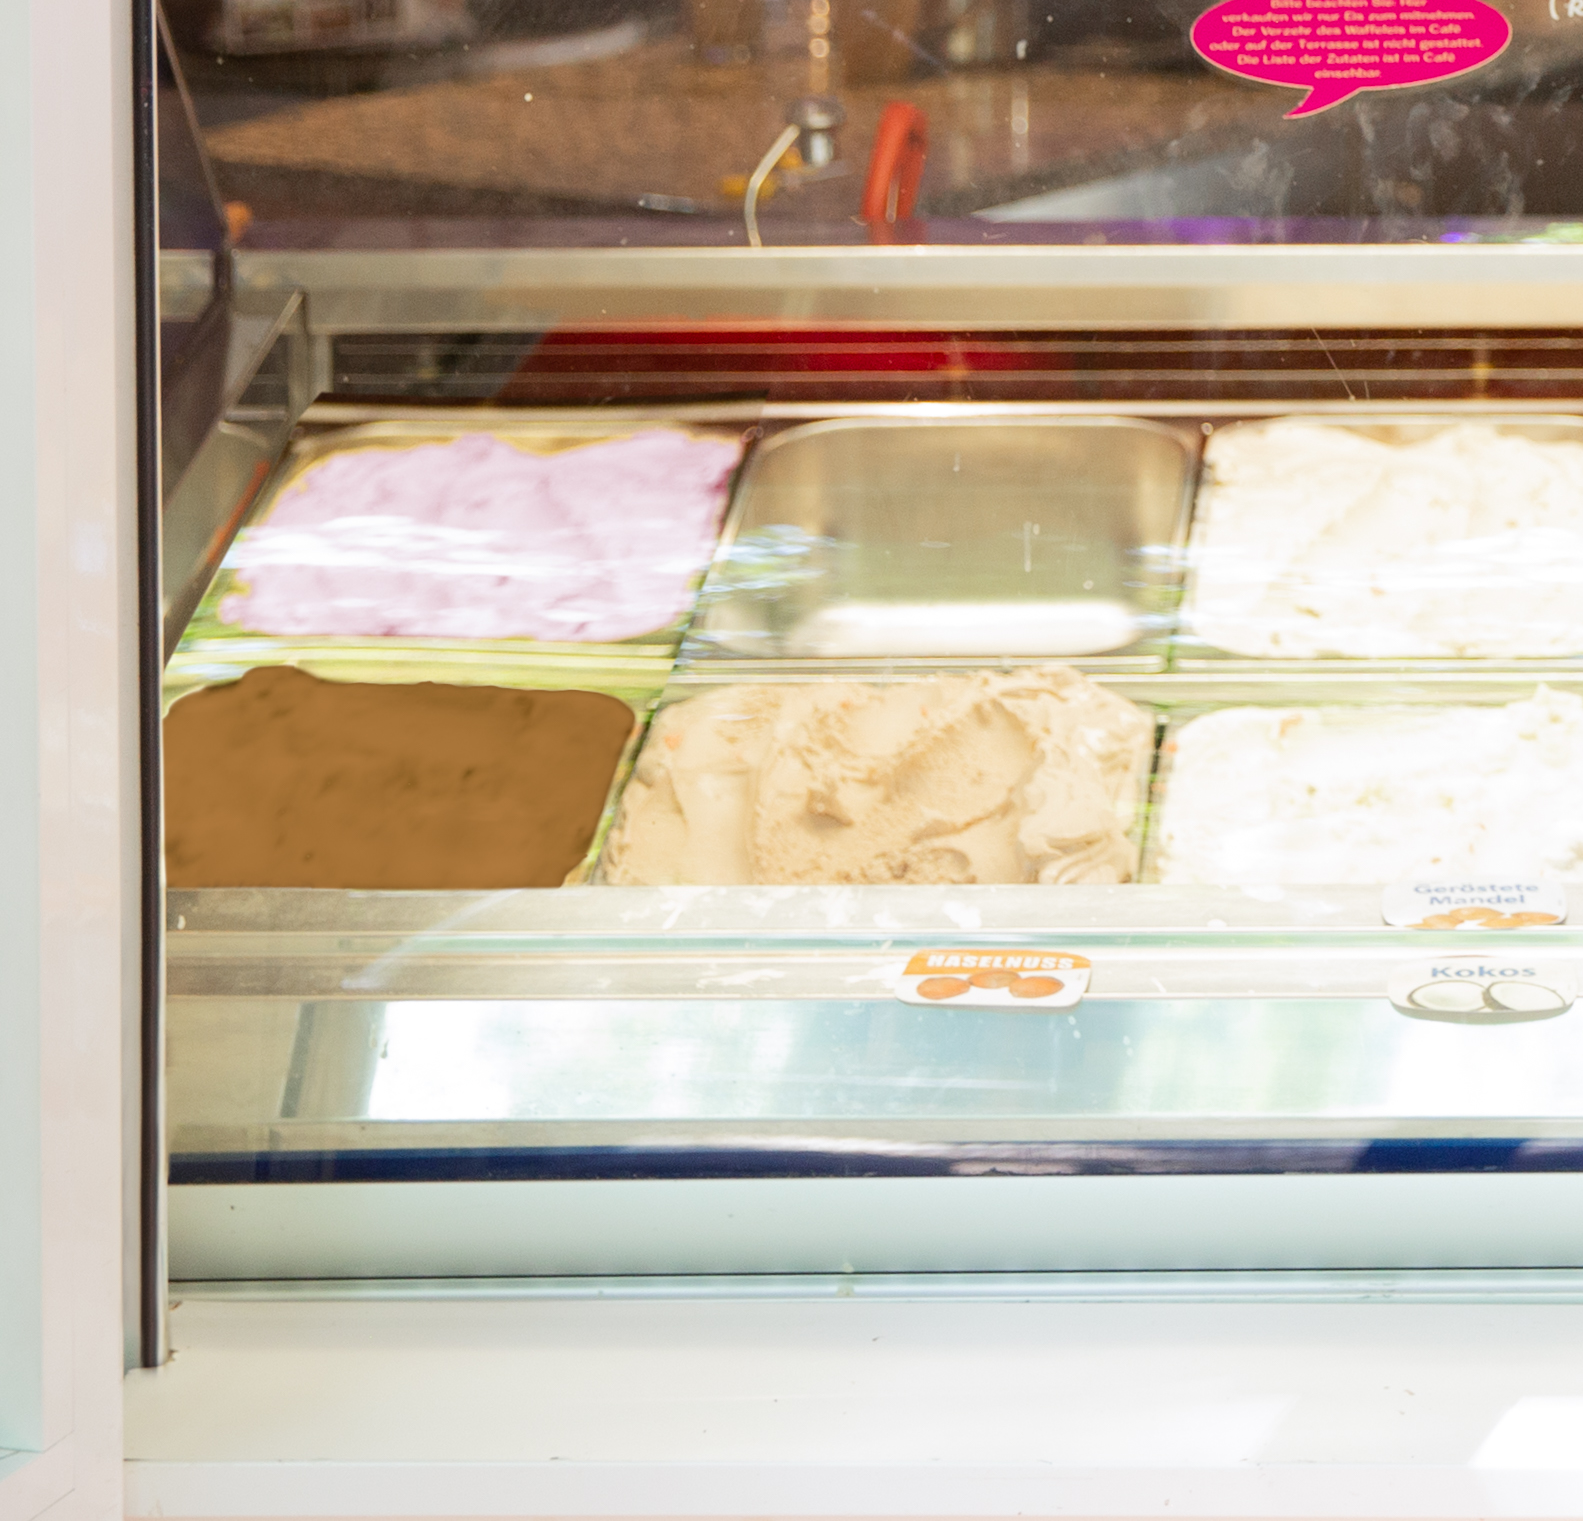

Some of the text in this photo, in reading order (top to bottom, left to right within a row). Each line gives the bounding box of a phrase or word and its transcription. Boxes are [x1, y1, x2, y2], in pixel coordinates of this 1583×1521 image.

[1414, 880, 1540, 896] Geröstete
[1428, 892, 1527, 907] Mandel
[926, 953, 1074, 972] HASELNUSS
[1430, 963, 1538, 980] Kokos
